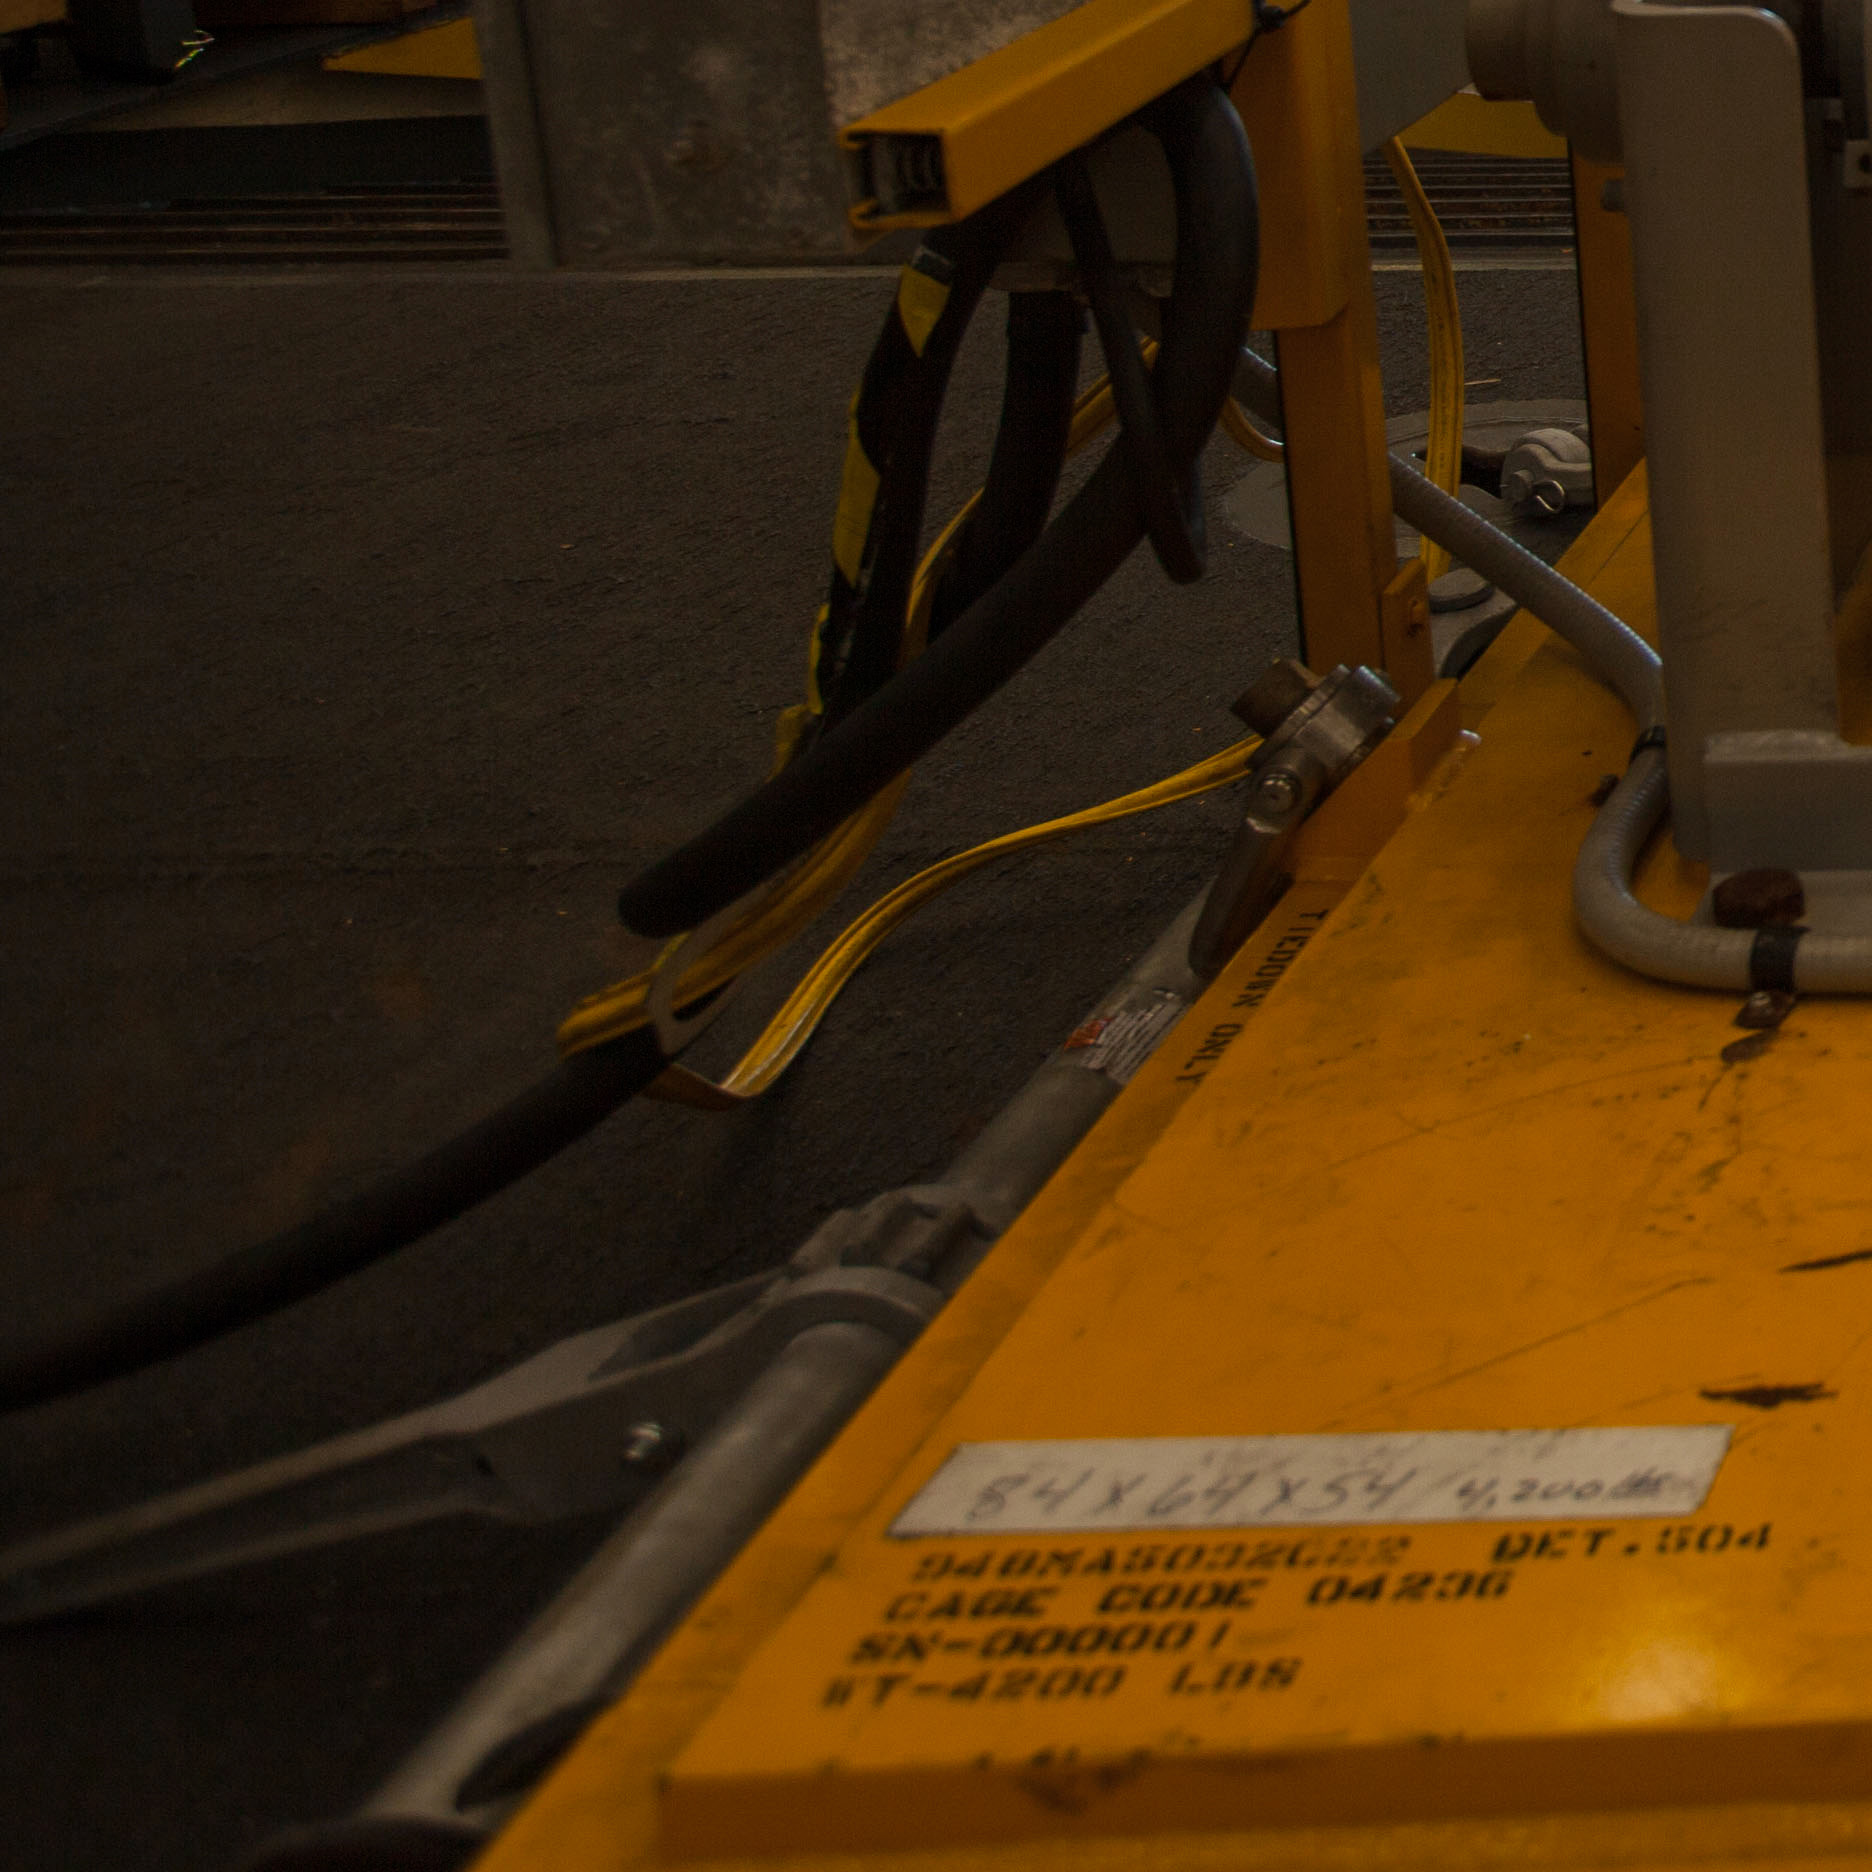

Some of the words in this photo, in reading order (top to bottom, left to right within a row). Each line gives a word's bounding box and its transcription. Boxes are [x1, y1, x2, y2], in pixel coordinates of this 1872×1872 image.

[1233, 909, 1330, 1008] TIEDOWN
[1176, 1023, 1244, 1085] ONLY
[1147, 1469, 1258, 1518] 64
[884, 1584, 1059, 1625] CAGE
[1096, 1577, 1269, 1616] CODE
